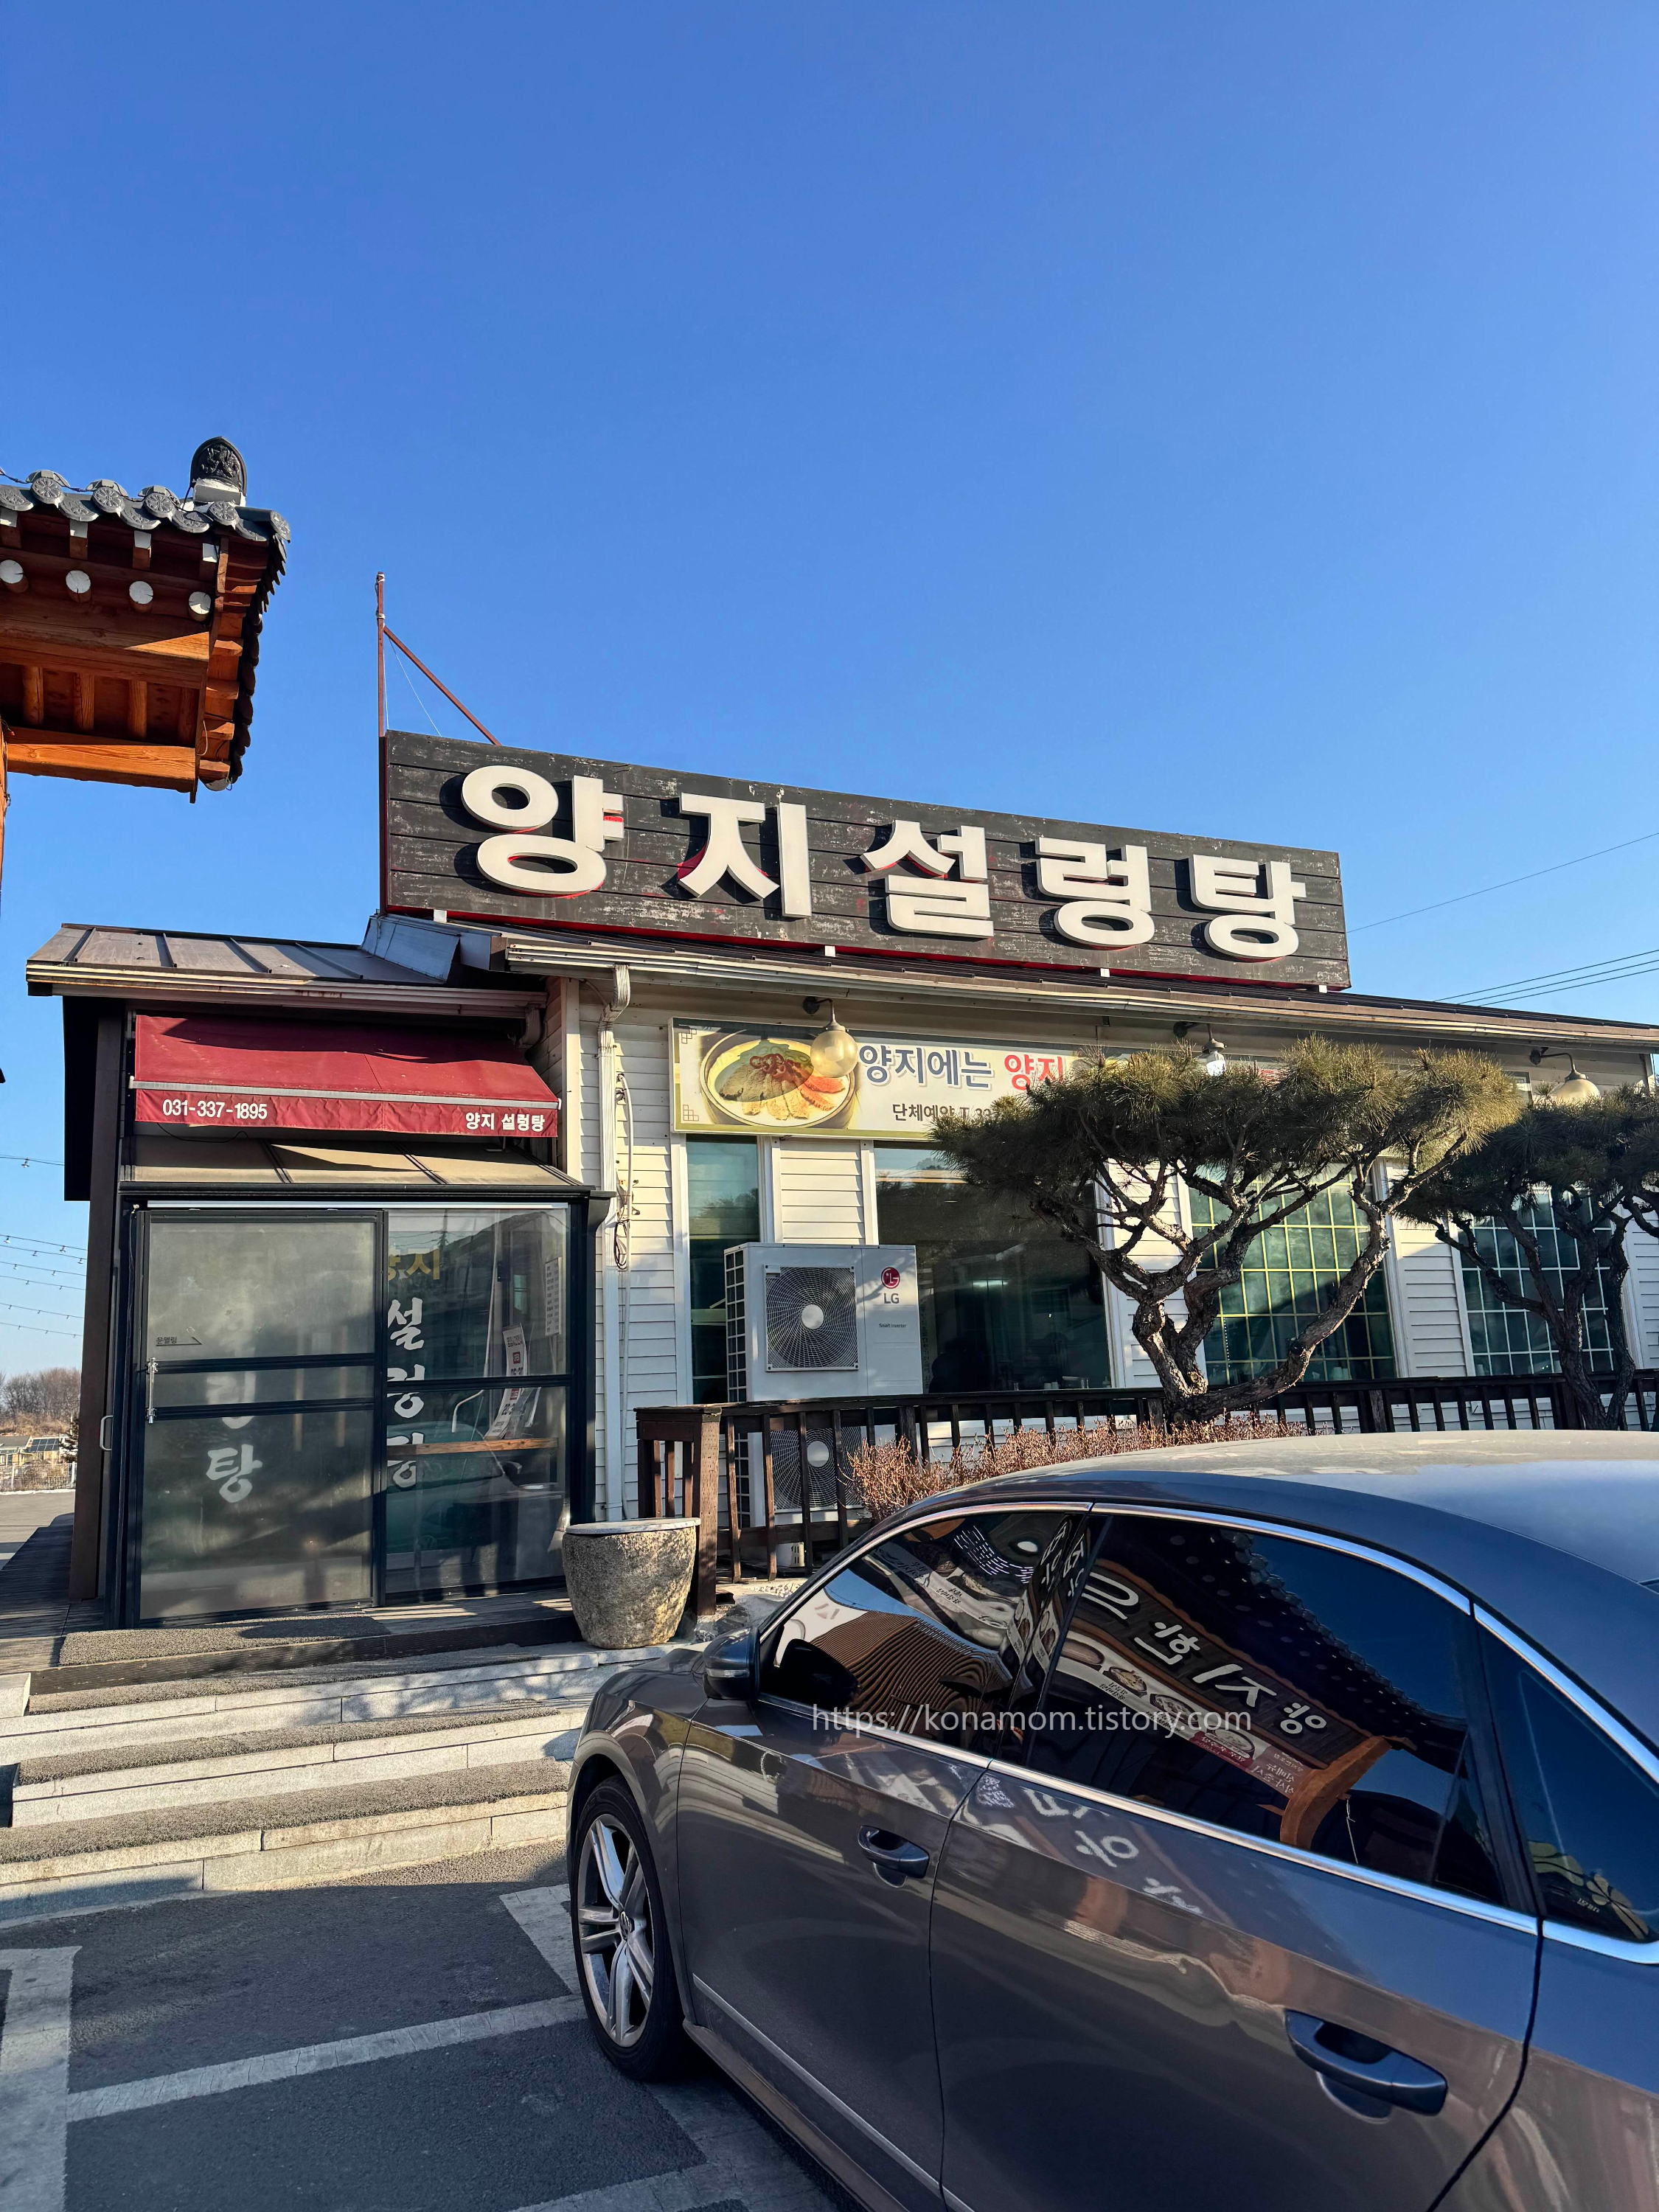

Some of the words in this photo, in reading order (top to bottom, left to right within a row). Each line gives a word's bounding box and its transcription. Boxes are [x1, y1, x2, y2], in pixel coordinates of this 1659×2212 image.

[462, 765, 1307, 961] 양지설렁탕
[858, 1045, 992, 1089] 양지에는
[162, 1099, 268, 1119] 031-337-1895
[465, 1112, 495, 1130] 양지
[501, 1113, 545, 1132] 설렁탕
[883, 1293, 900, 1304] LG
